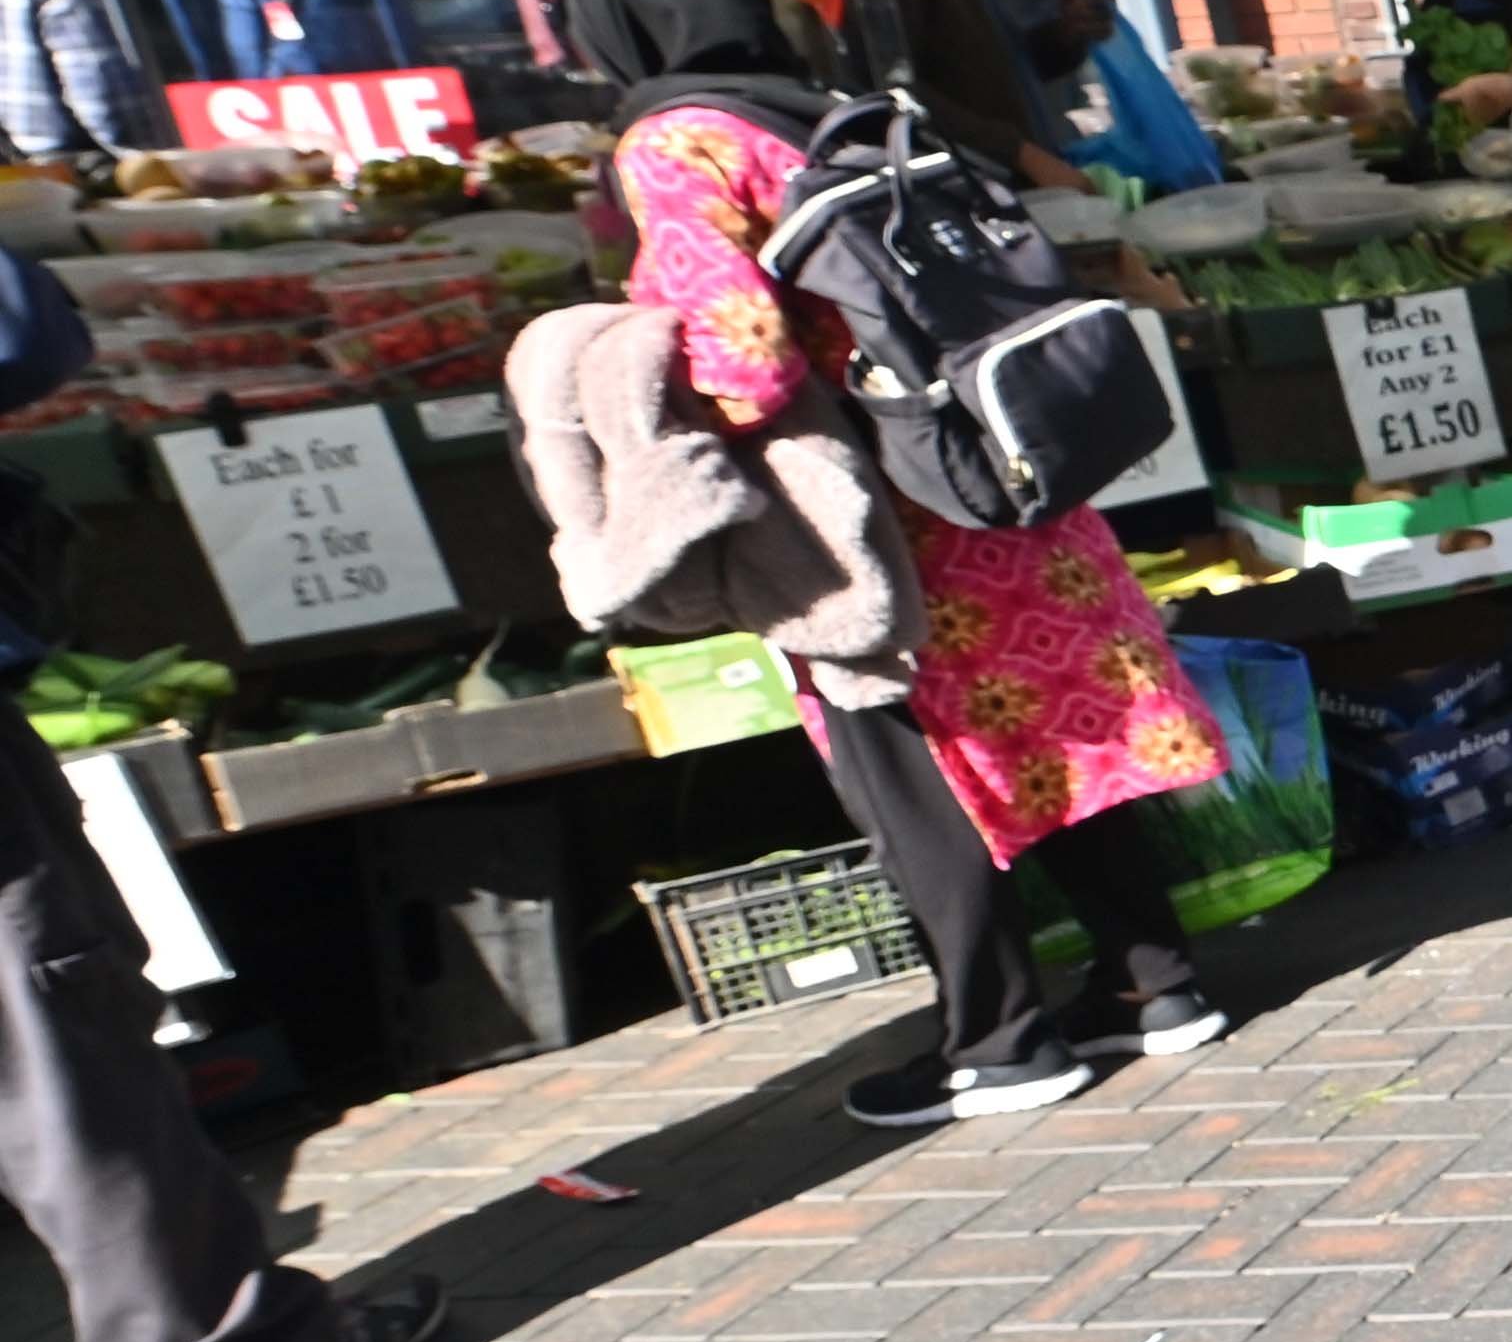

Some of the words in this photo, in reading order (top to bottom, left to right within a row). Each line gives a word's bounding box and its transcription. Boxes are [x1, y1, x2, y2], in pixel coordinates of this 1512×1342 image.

[207, 77, 460, 166] SALE
[1360, 344, 1412, 369] for
[1379, 371, 1434, 396] Any
[1439, 364, 1459, 385] 2
[1377, 397, 1482, 455] £1.50
[210, 444, 307, 486] Each
[306, 437, 360, 472] for
[285, 531, 316, 564] 2
[319, 524, 373, 559] for
[289, 563, 389, 608] £1.50
